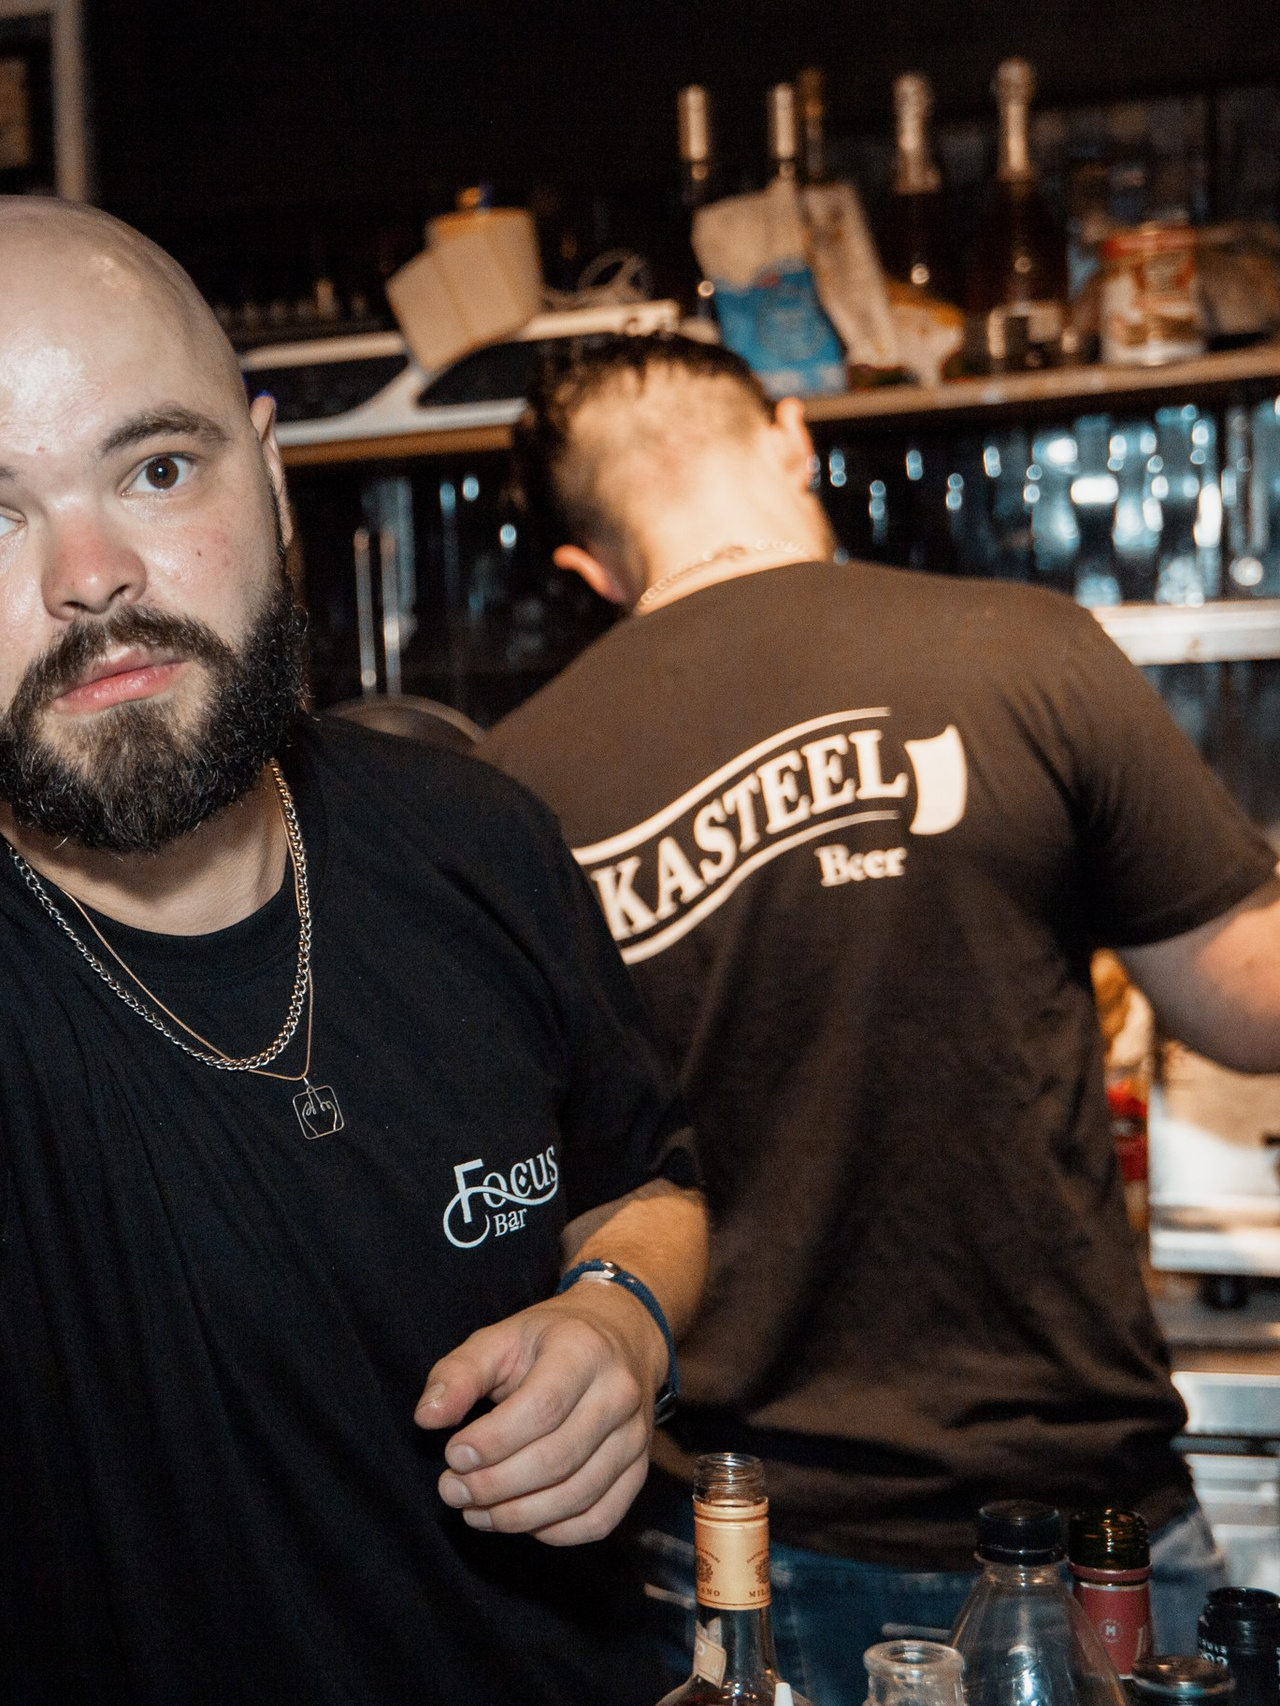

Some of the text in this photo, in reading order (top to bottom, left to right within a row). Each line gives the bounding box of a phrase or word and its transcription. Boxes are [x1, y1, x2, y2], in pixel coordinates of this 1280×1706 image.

[590, 729, 908, 942] KASTEEL
[814, 844, 907, 887] Beer
[493, 1208, 528, 1237] Bar
